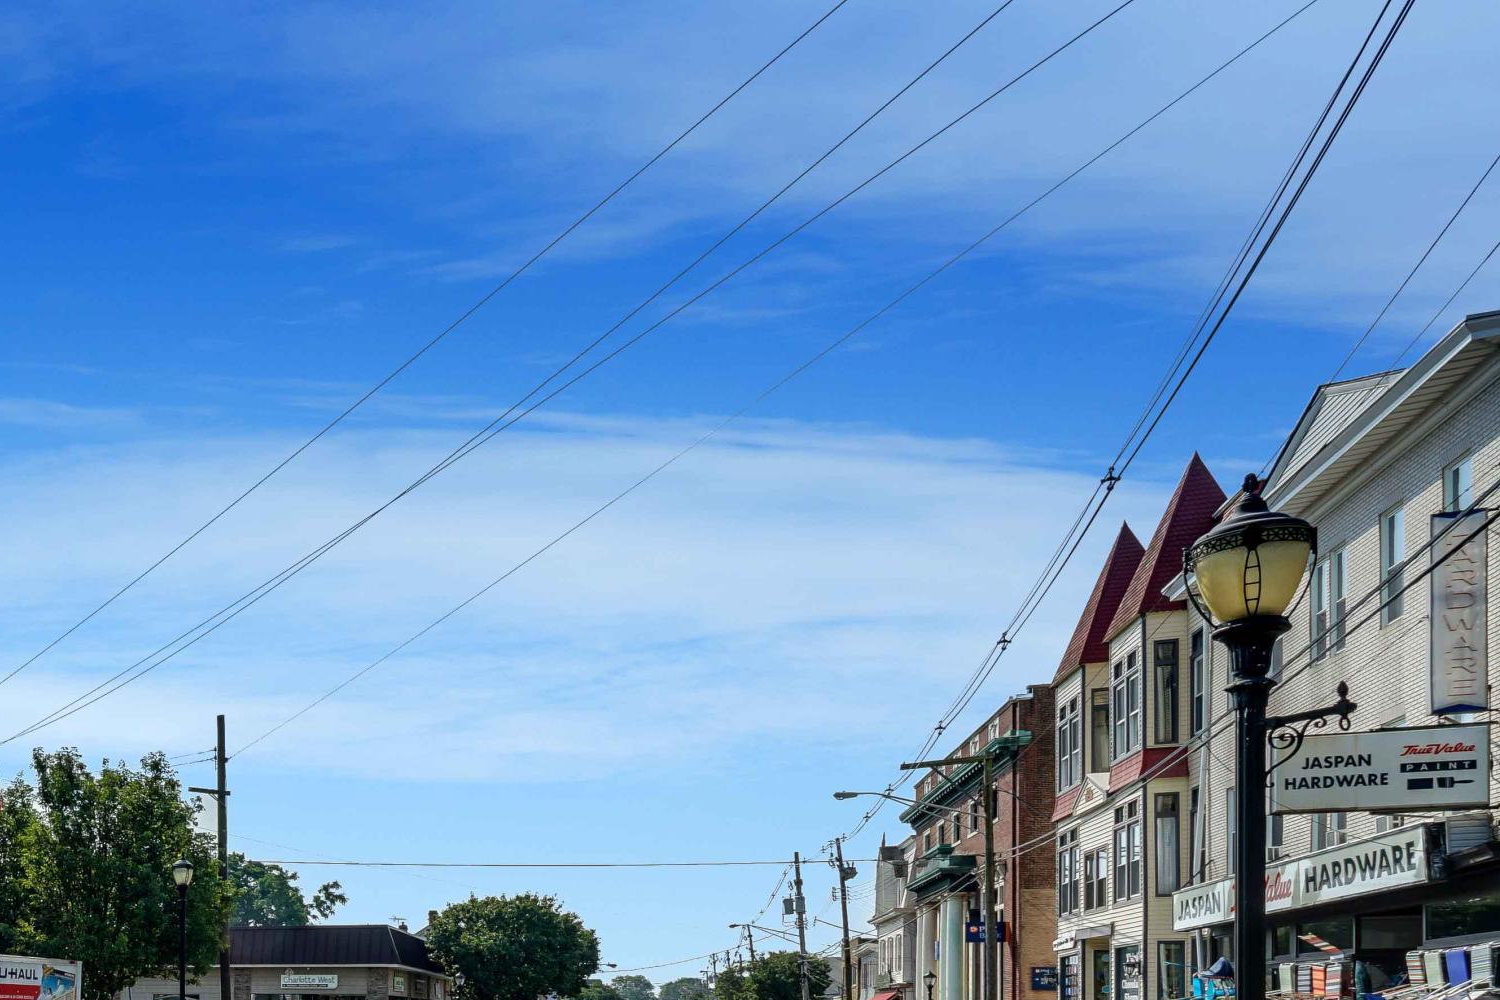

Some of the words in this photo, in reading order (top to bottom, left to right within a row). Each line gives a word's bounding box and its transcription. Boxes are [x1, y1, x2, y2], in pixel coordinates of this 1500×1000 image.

[1301, 753, 1372, 770] JASPAN
[1406, 760, 1471, 772] PAINT
[1284, 772, 1389, 790] HARDWARE
[1304, 841, 1417, 894] HARDWARE
[1178, 890, 1221, 921] JASPAN
[283, 976, 316, 984] Charlotte
[317, 976, 336, 984] West
